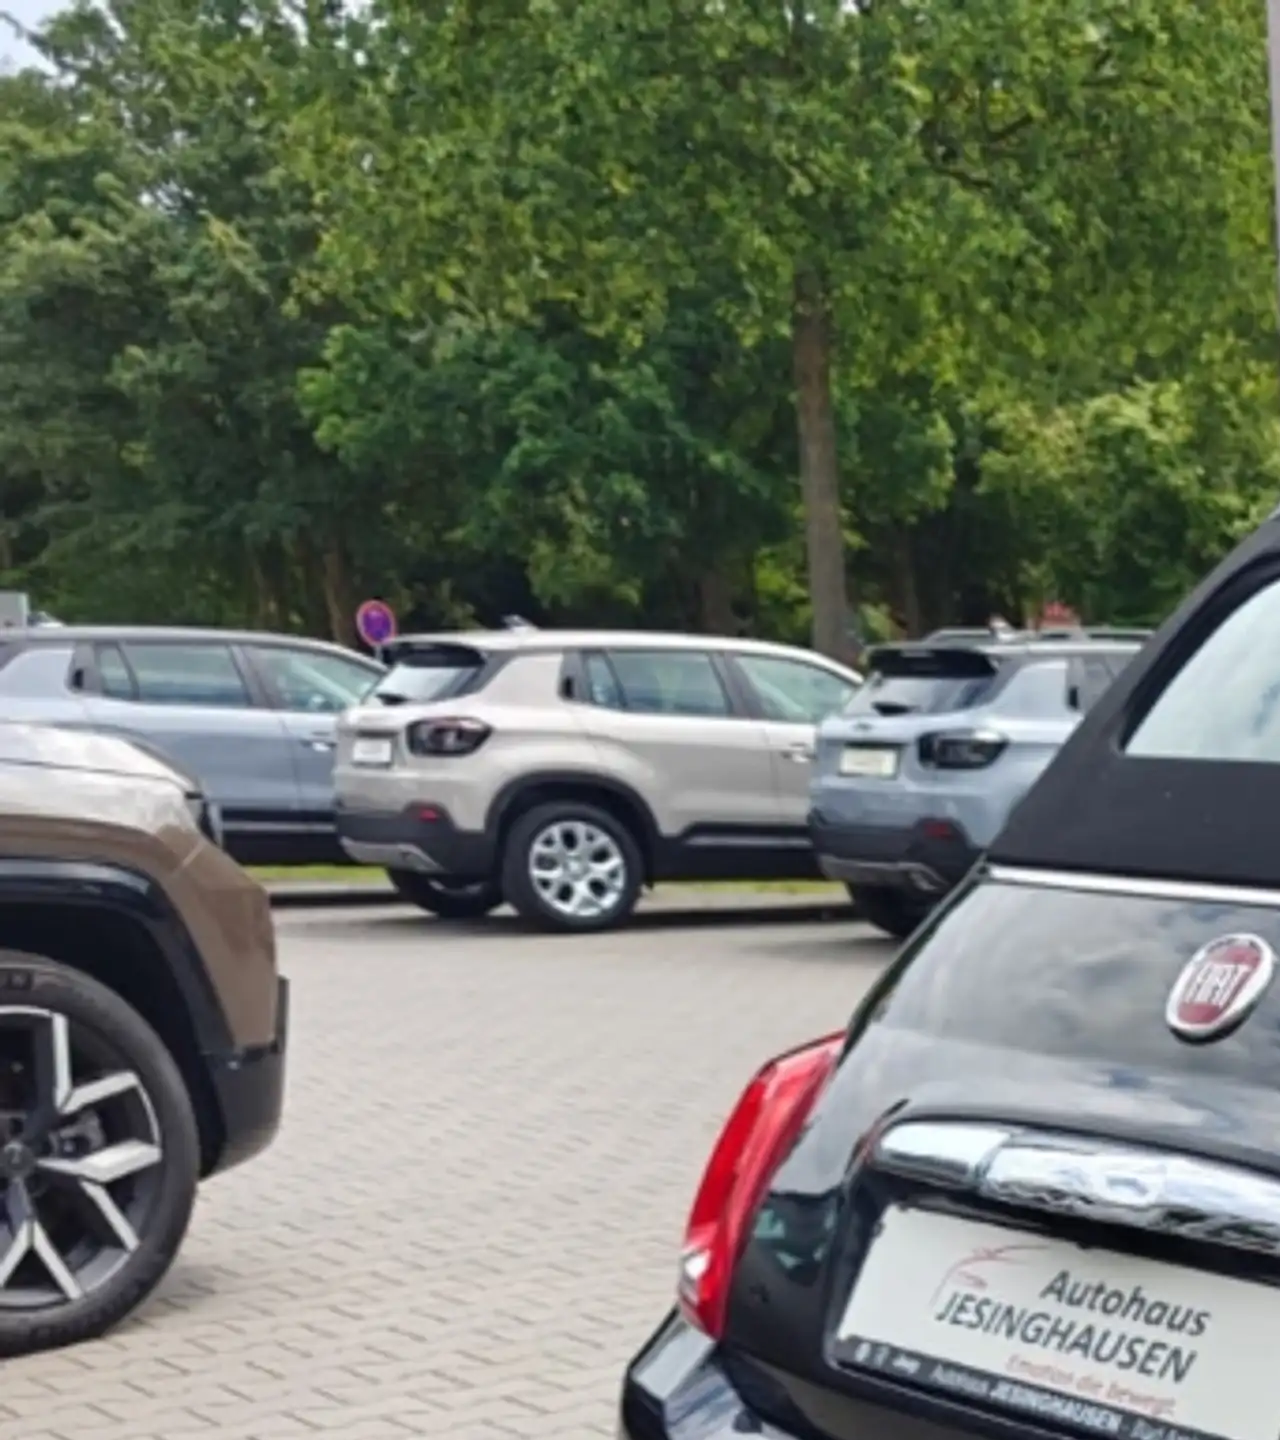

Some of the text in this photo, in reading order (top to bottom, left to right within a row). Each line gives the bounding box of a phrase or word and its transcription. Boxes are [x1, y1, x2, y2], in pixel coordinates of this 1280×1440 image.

[1184, 963, 1249, 1008] FIAT
[1038, 1269, 1212, 1337] Autohaus
[934, 1291, 1199, 1384] JESINGHAUSEN
